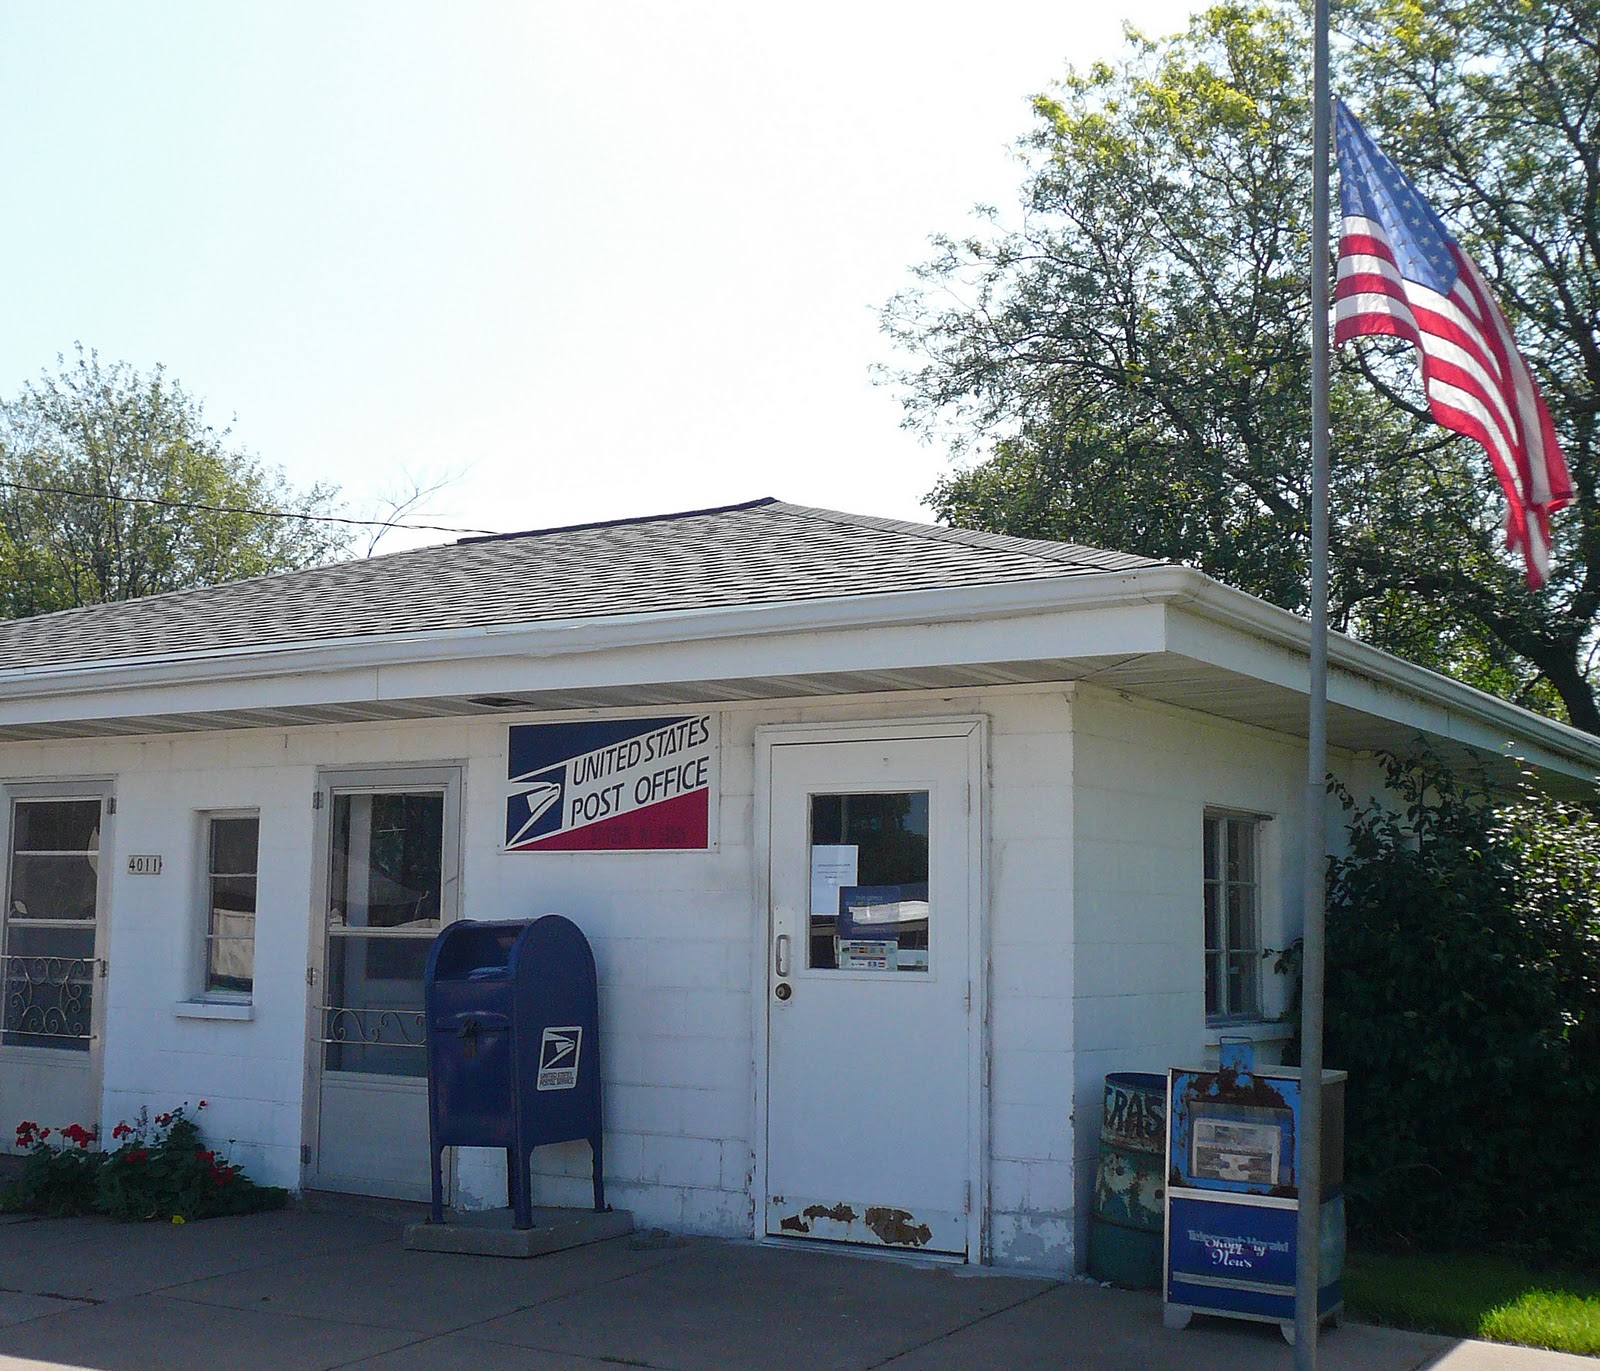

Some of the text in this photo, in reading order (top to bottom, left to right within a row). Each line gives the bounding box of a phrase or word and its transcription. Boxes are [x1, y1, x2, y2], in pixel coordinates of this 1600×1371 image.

[573, 715, 710, 786] UNITED STATES
[571, 756, 710, 827] POST OFFICE
[129, 857, 157, 872] 4011
[1104, 1085, 1166, 1138] TRAS
[1211, 1248, 1253, 1268] News
